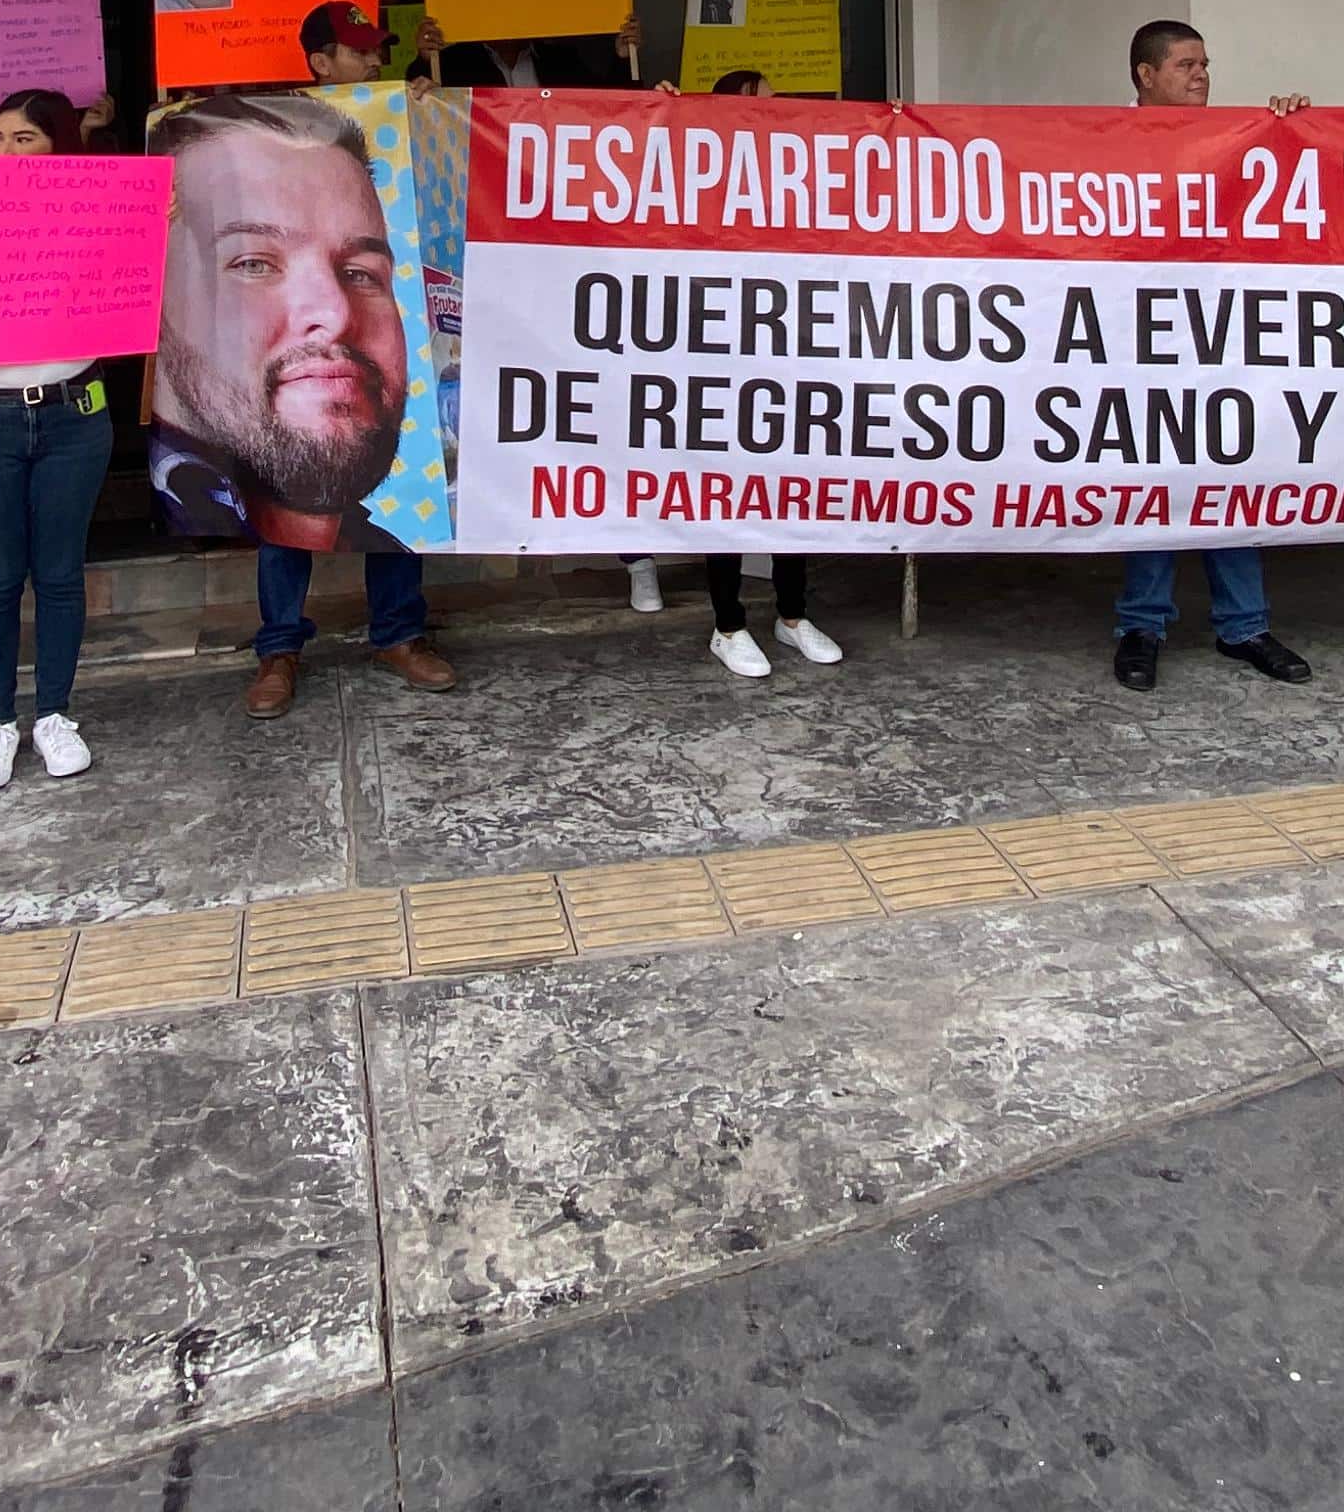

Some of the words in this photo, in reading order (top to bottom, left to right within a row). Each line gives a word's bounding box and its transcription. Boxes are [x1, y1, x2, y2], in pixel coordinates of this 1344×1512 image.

[17, 157, 119, 171] AUTORIDAD
[26, 176, 108, 191] FUERAN
[119, 177, 157, 192] TUS
[508, 123, 1005, 237] DESAPARECIDO
[1021, 170, 1164, 238] DESDE
[1178, 172, 1229, 240] EL
[1241, 145, 1327, 242] 24
[43, 199, 63, 214] TU
[70, 199, 100, 215] QUE
[7, 248, 29, 263] MI
[36, 248, 105, 263] FAMILIA
[78, 268, 104, 283] MIS
[575, 271, 1026, 364] QUEREMOS
[1053, 286, 1109, 365] A
[497, 367, 600, 444] DE
[628, 375, 1005, 462] REGRESO
[1034, 384, 1255, 465] SANO
[1283, 389, 1338, 464] Y
[532, 465, 606, 518] NO
[627, 470, 974, 525] PARAREMOS
[991, 482, 1171, 530] HASTA
